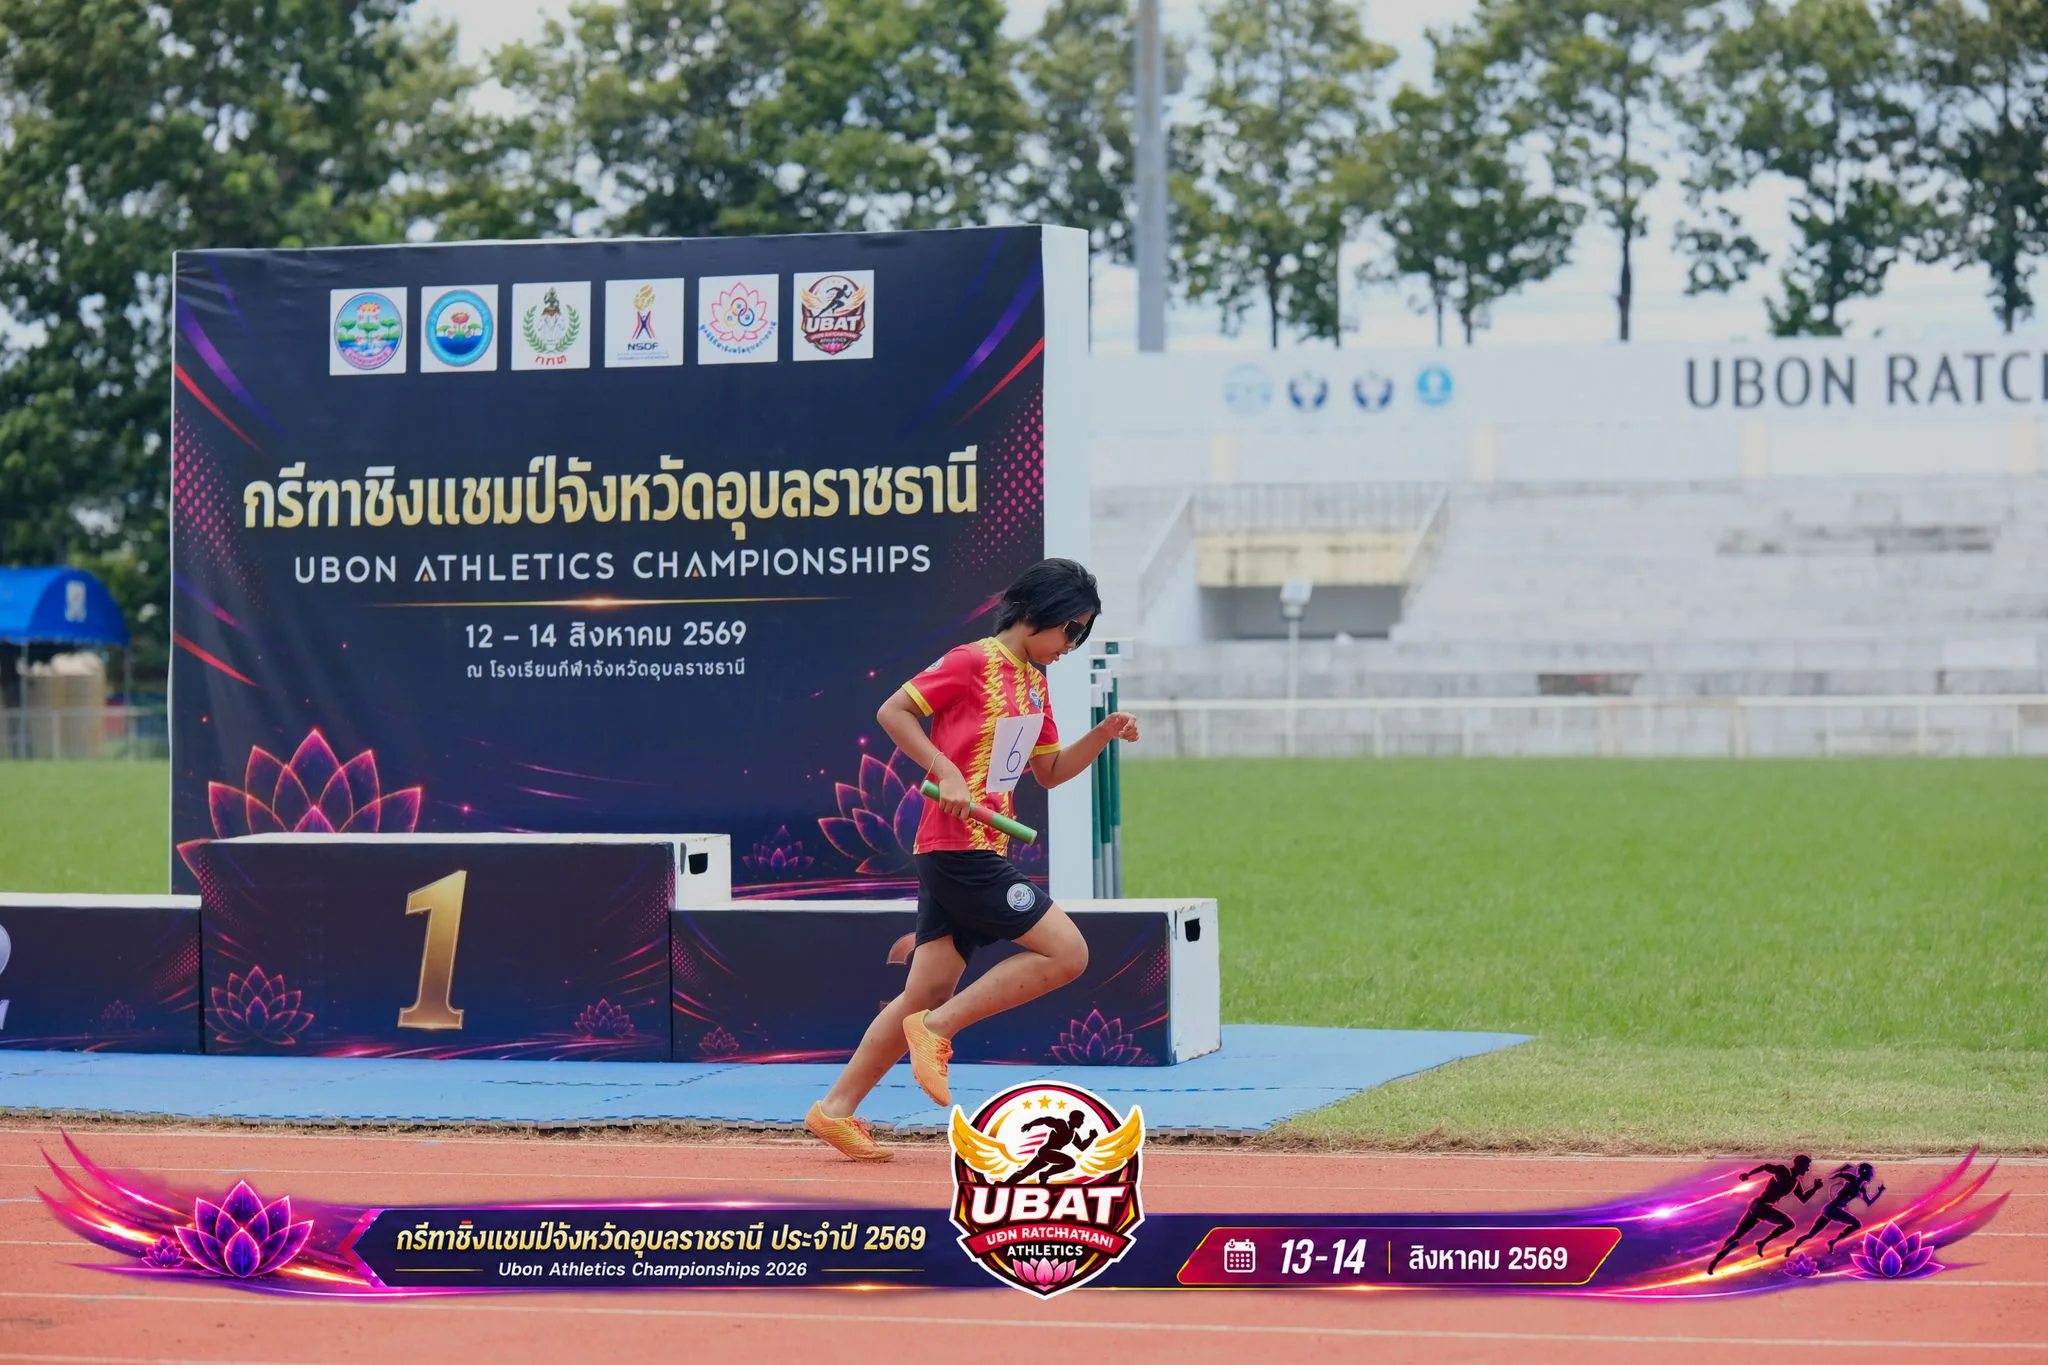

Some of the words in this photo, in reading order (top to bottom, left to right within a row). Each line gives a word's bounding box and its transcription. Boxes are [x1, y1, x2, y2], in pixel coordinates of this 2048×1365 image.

[806, 316, 861, 332] UBAT
[1687, 357, 1856, 408] UBON
[1887, 352, 2048, 405] RATC
[243, 444, 978, 541] กรีฑาชิงแชมป์จังหวัดอุบลราชธานี
[295, 555, 396, 583] UBON
[414, 552, 615, 582] ATHLETICS
[633, 545, 931, 579] CHAMPIONSHIPS
[465, 623, 493, 648] 12
[529, 623, 557, 648] 14
[569, 621, 671, 648] สิงหาคม
[683, 620, 747, 646] 2569
[467, 664, 482, 678] ณ
[489, 657, 745, 681] โรงเรียนกีฬาจังหวัดอุบลราชธานี
[1006, 725, 1024, 773] 6
[397, 870, 468, 1031] 1
